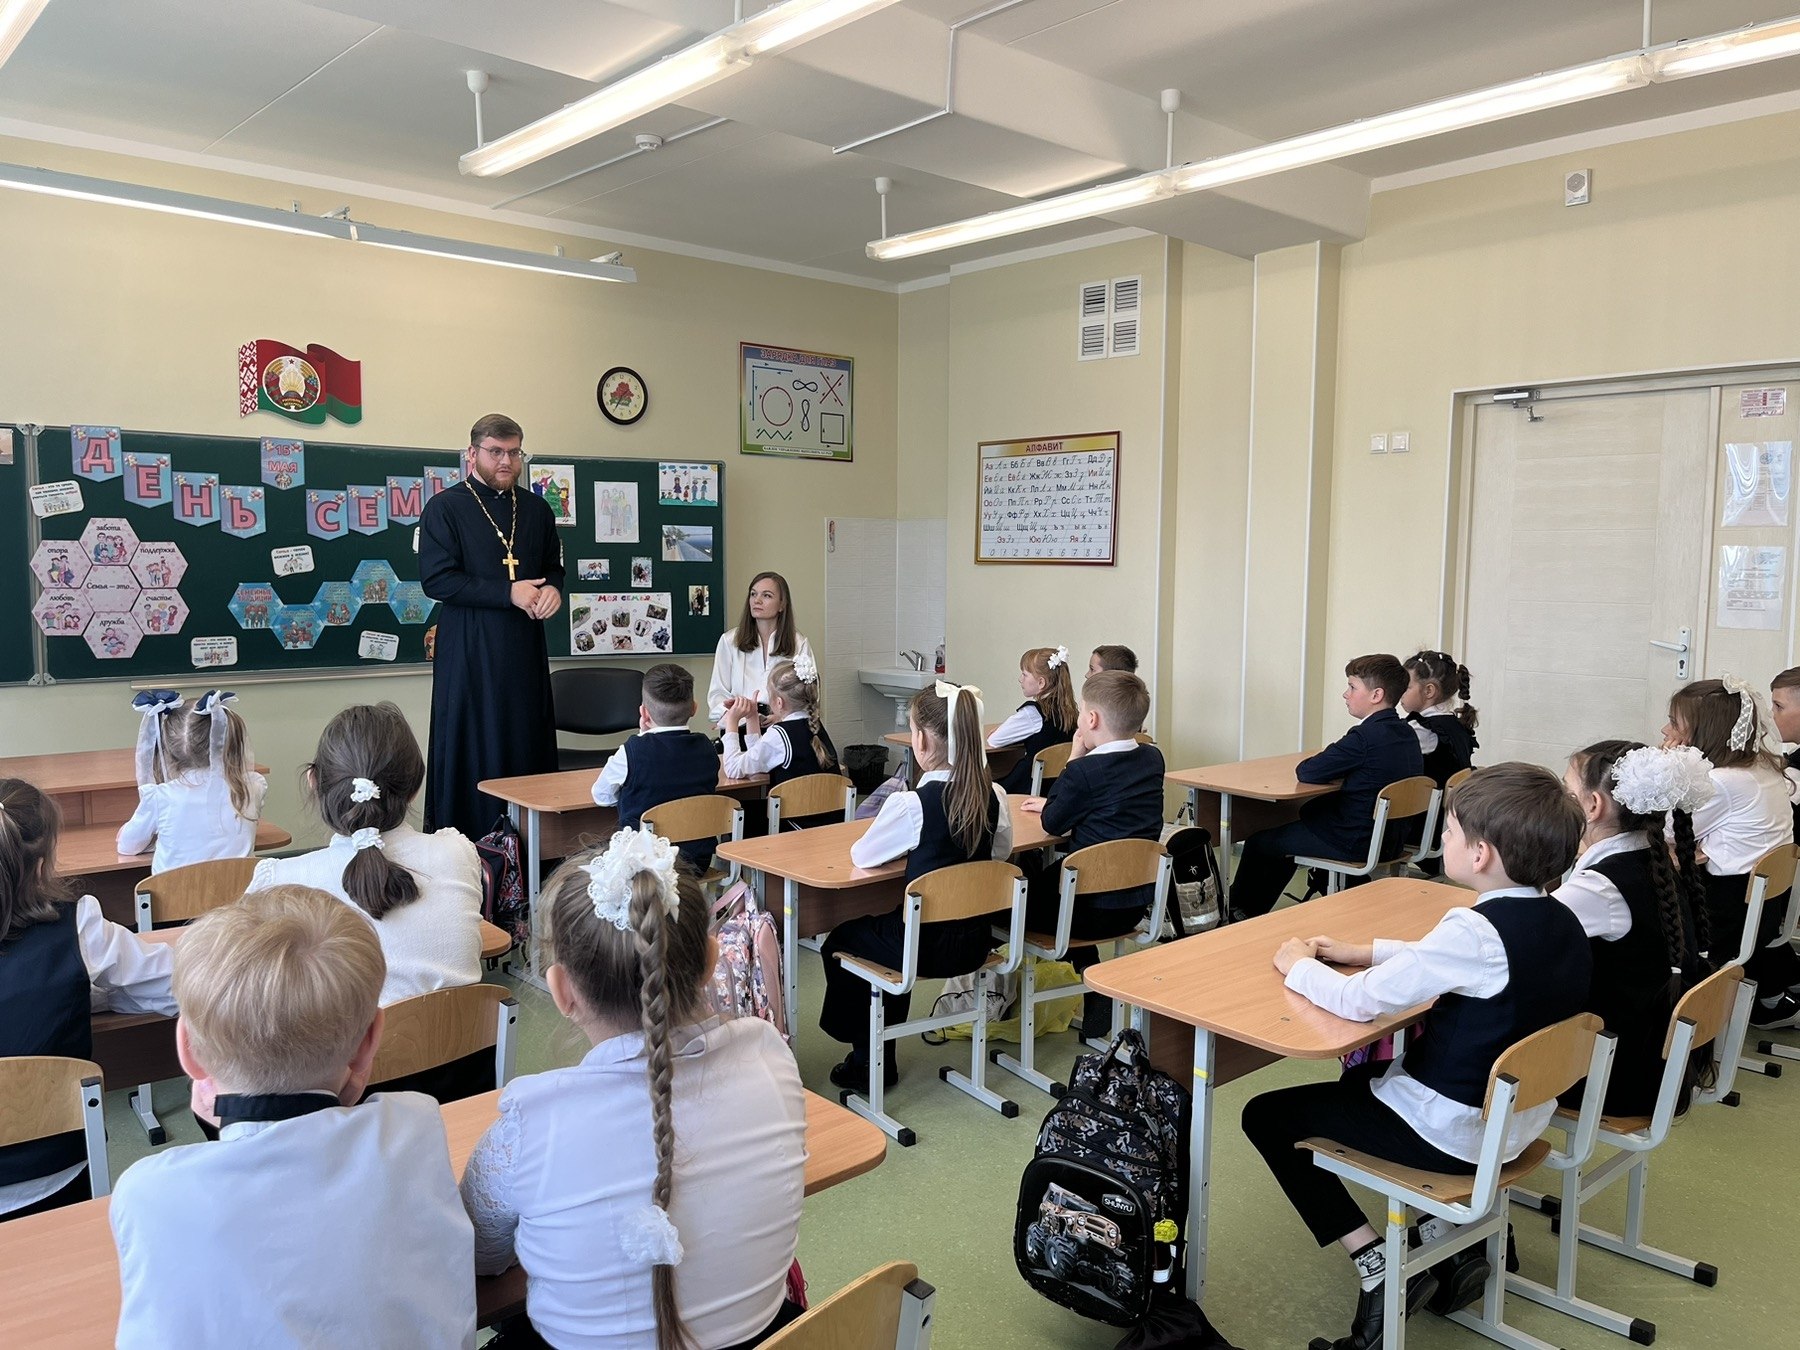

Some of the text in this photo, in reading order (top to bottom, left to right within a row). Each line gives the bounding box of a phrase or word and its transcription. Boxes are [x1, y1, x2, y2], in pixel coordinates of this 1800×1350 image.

[275, 445, 291, 456] 15
[1026, 442, 1064, 453] АЛФАВИТ
[268, 460, 298, 473] МАЯ
[81, 437, 258, 530] ДЕНЬ
[96, 523, 121, 531] забота
[140, 547, 176, 555] поддержка
[100, 618, 125, 626] дружба
[1105, 1198, 1133, 1213] SHUNYU
